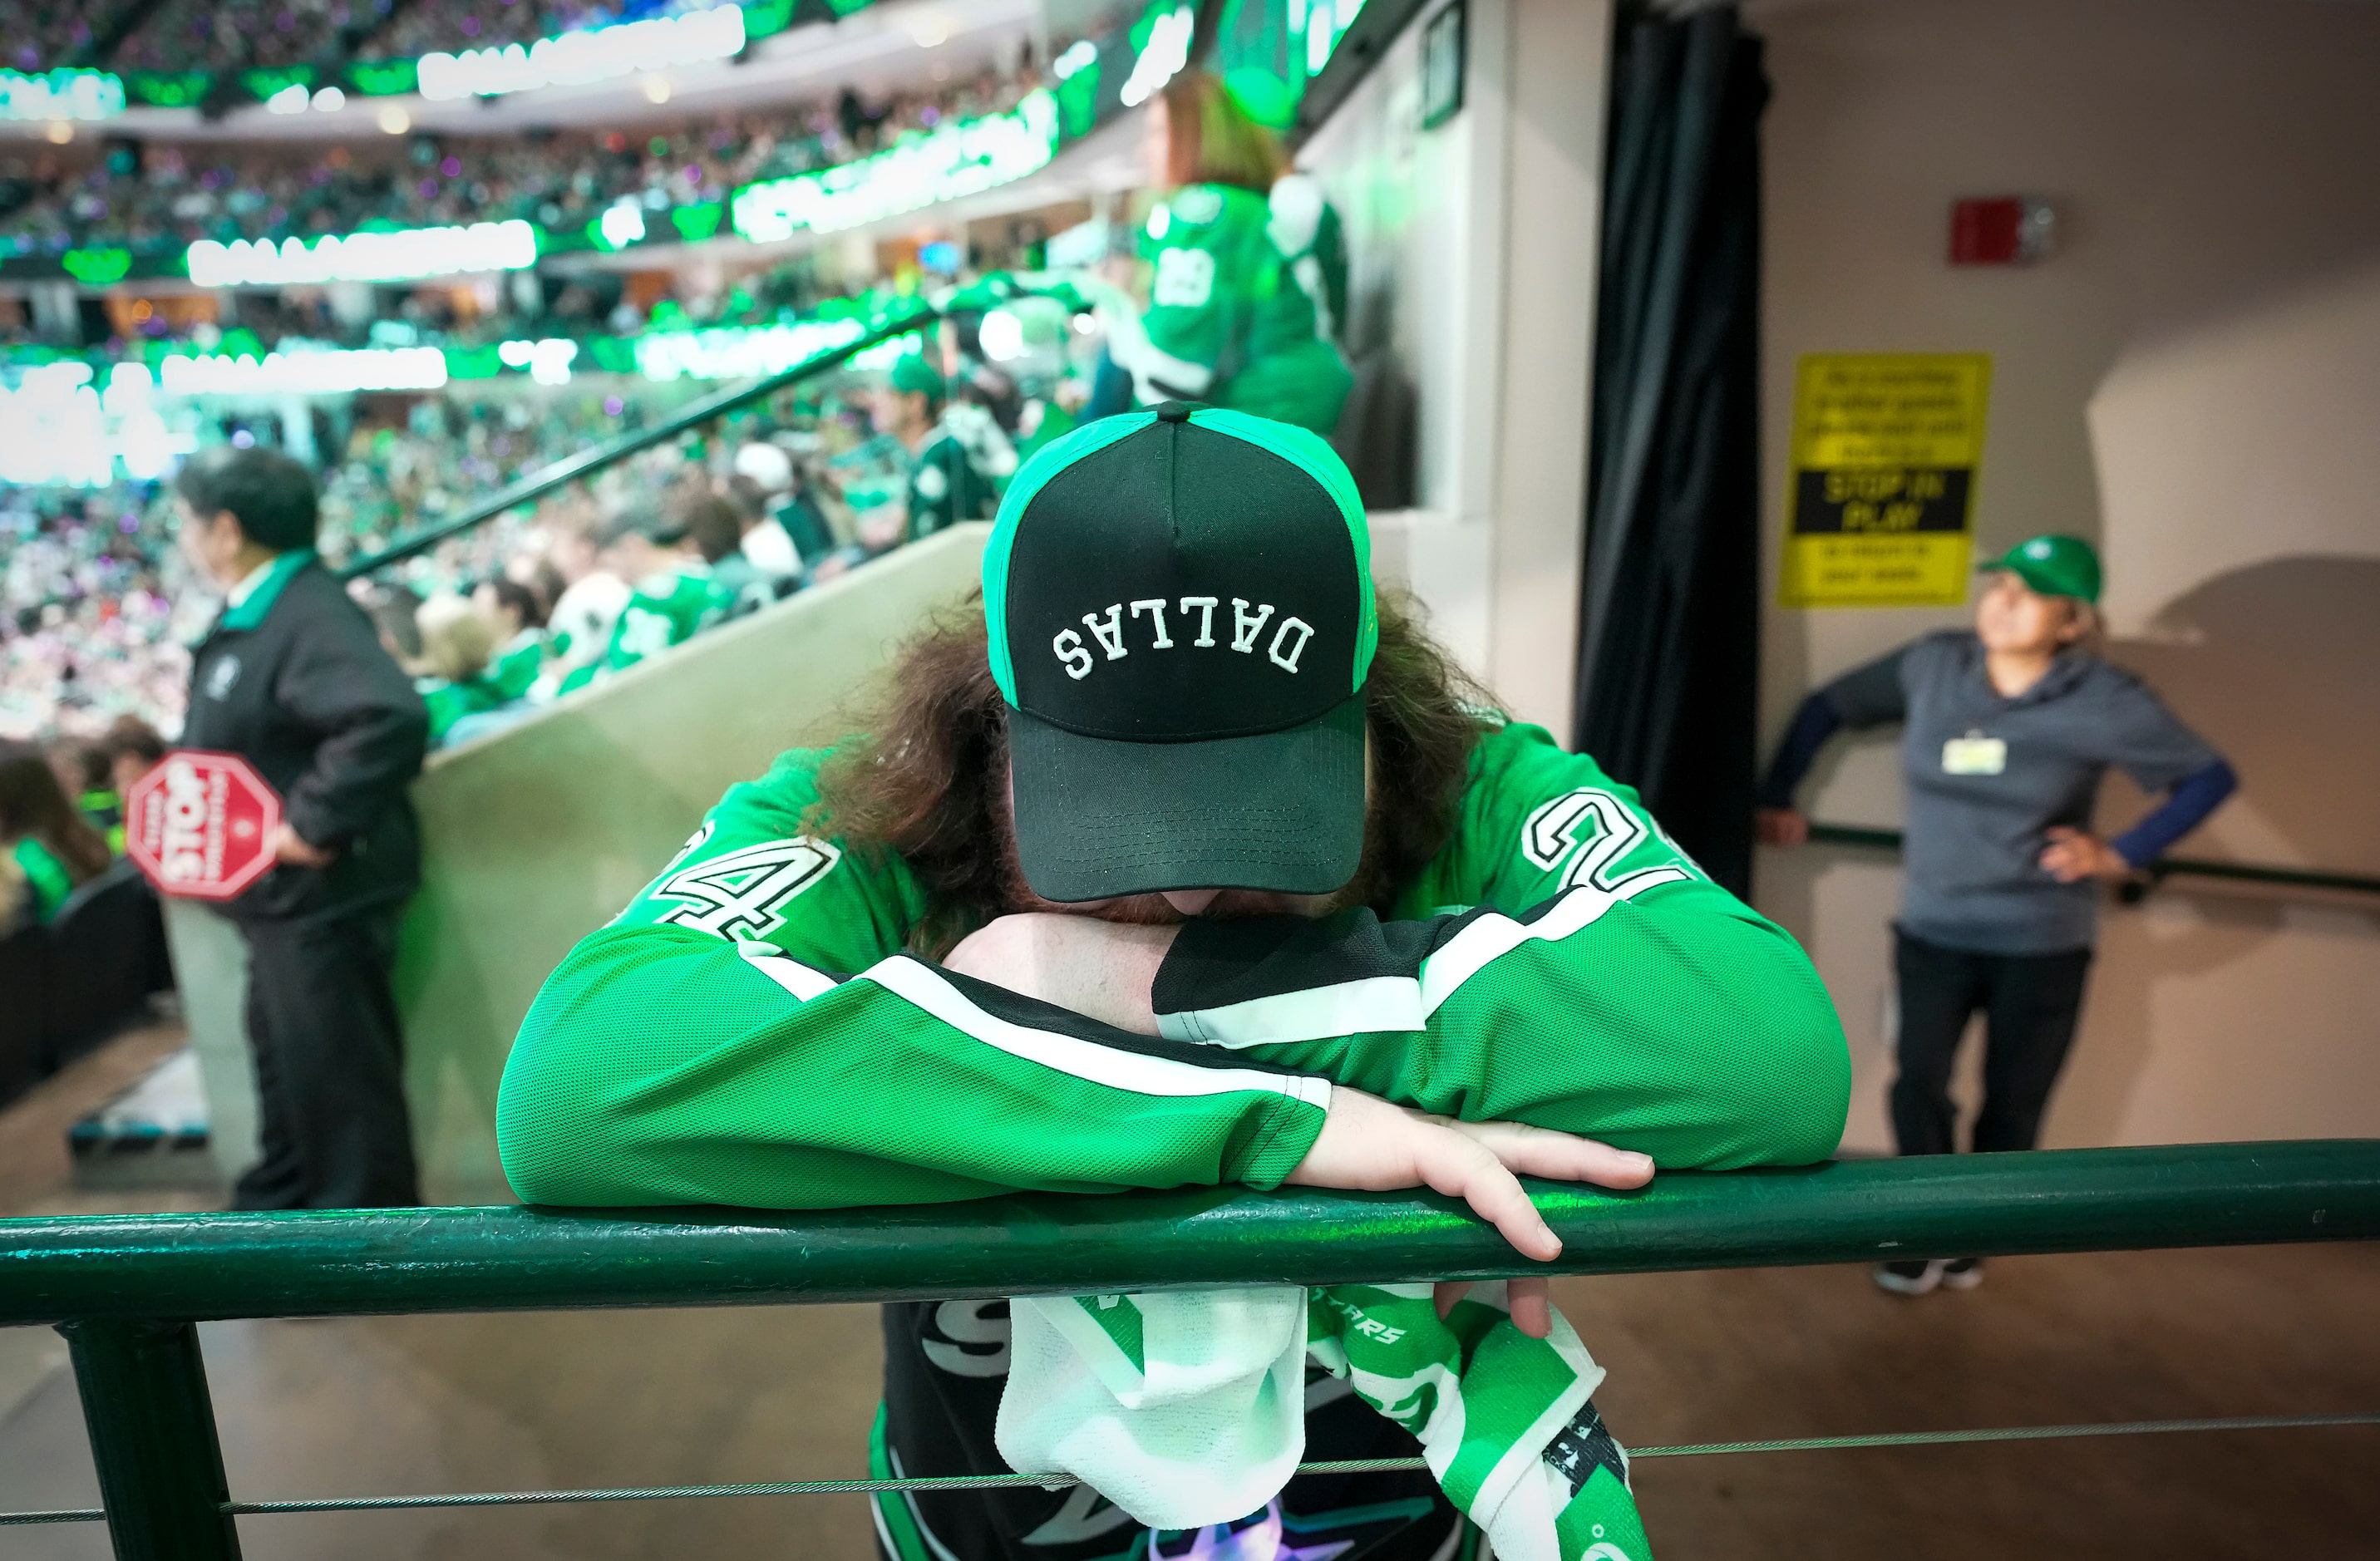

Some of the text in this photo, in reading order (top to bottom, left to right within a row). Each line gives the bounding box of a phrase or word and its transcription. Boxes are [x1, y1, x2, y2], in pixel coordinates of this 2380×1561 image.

[1052, 594, 1315, 682] DALLAS
[160, 760, 206, 883] STOP
[648, 820, 841, 943] 4
